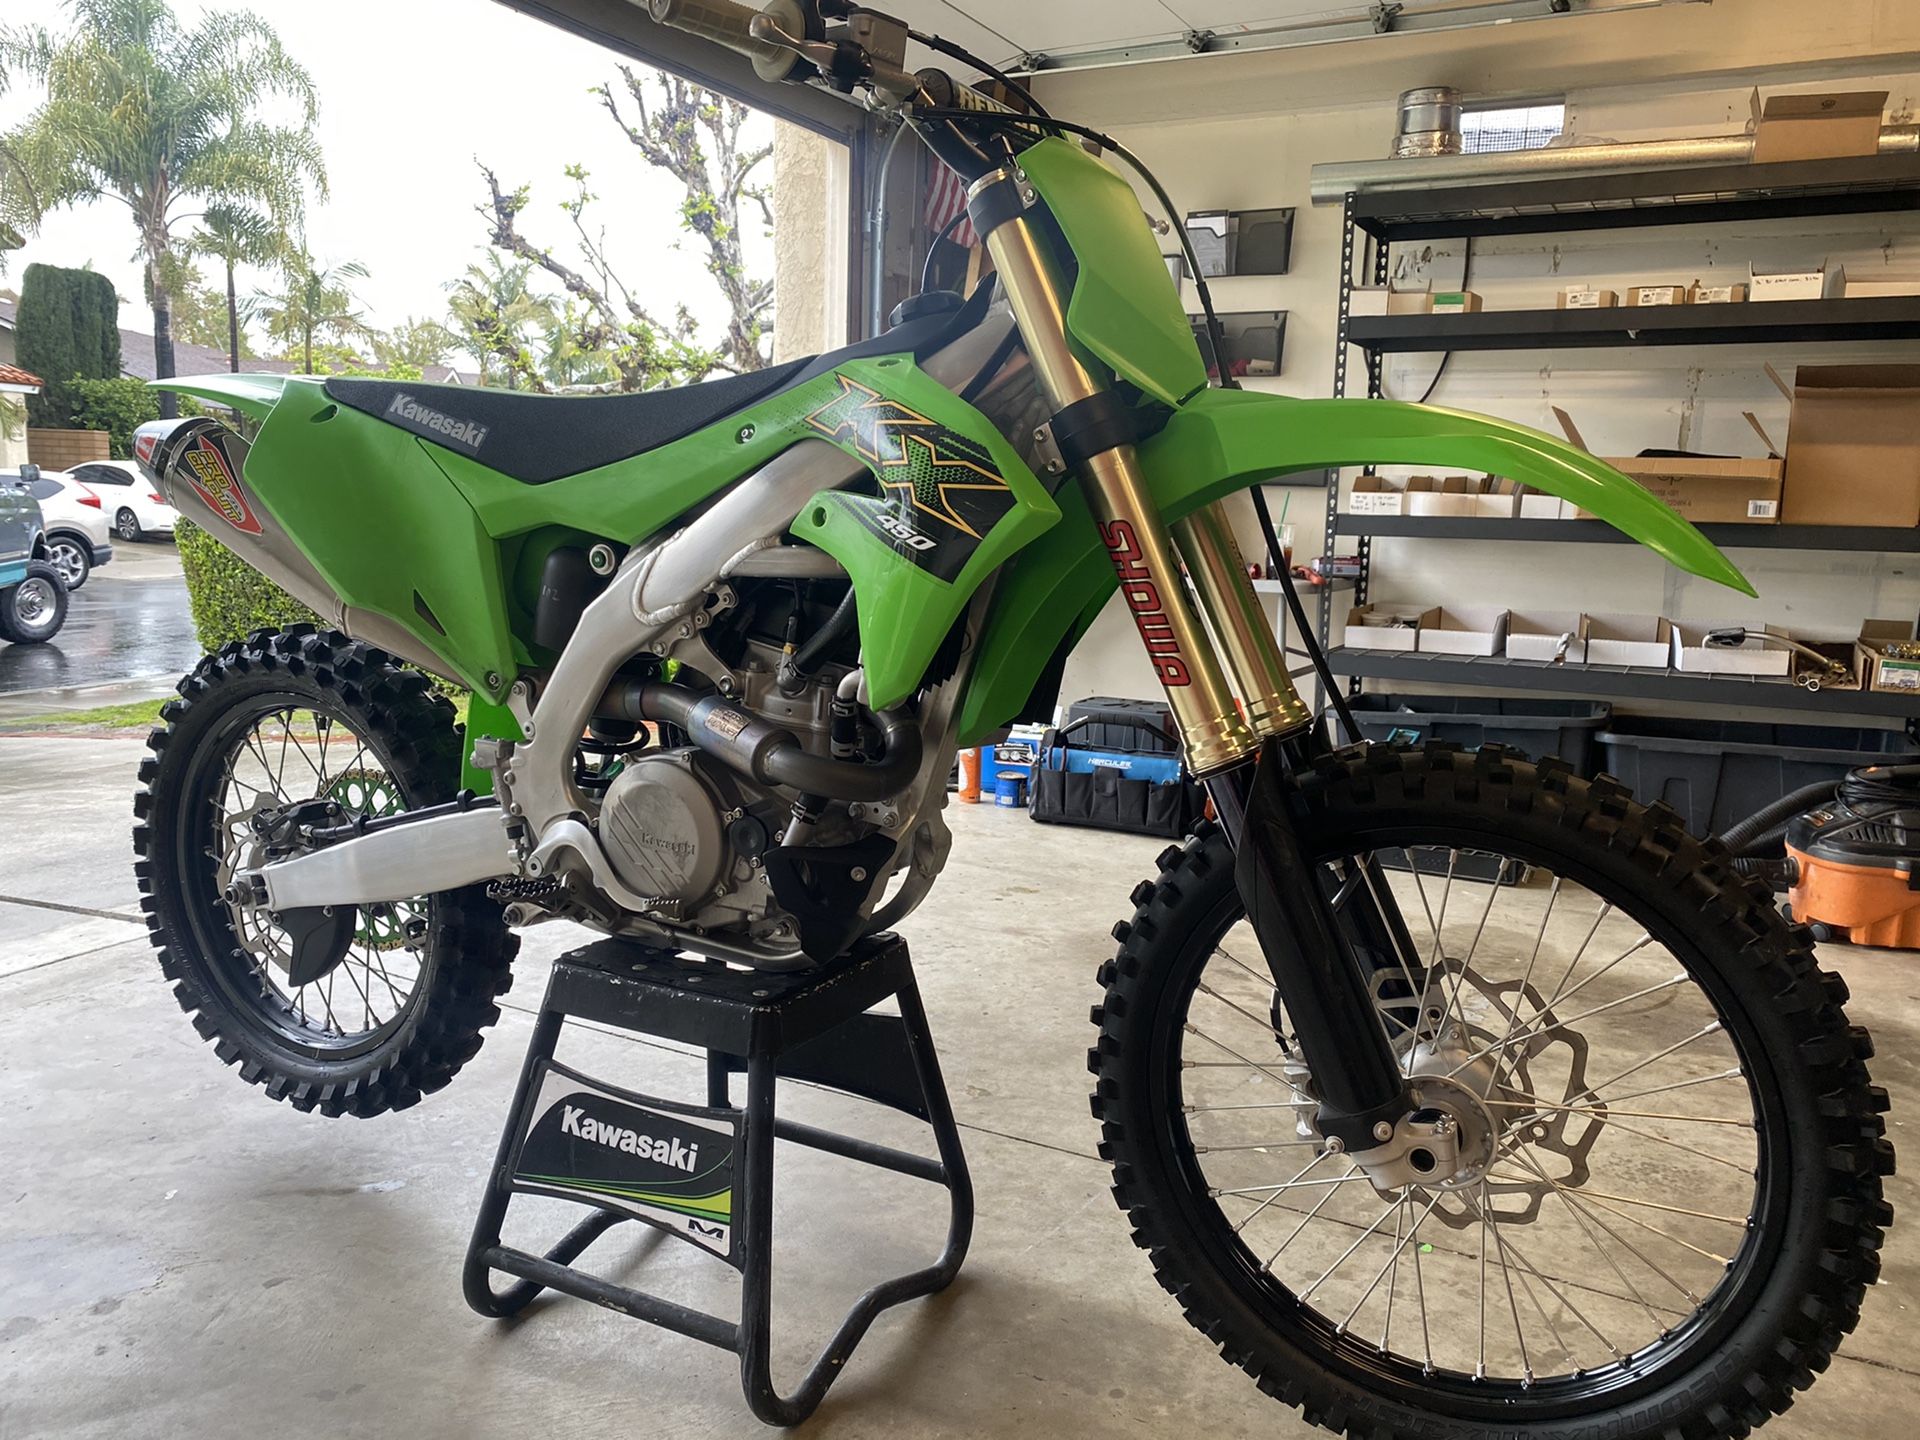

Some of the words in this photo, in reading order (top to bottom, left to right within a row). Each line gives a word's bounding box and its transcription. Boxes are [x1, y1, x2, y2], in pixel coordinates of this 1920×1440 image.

[389, 393, 486, 448] Kawasaki
[199, 450, 231, 490] PRO
[804, 372, 1010, 539] KX
[187, 452, 241, 522] CIRCUIT
[876, 514, 937, 551] 450
[1098, 519, 1191, 687] SHOWA
[641, 831, 696, 857] Kawasaki
[561, 1104, 699, 1173] Kawasaki
